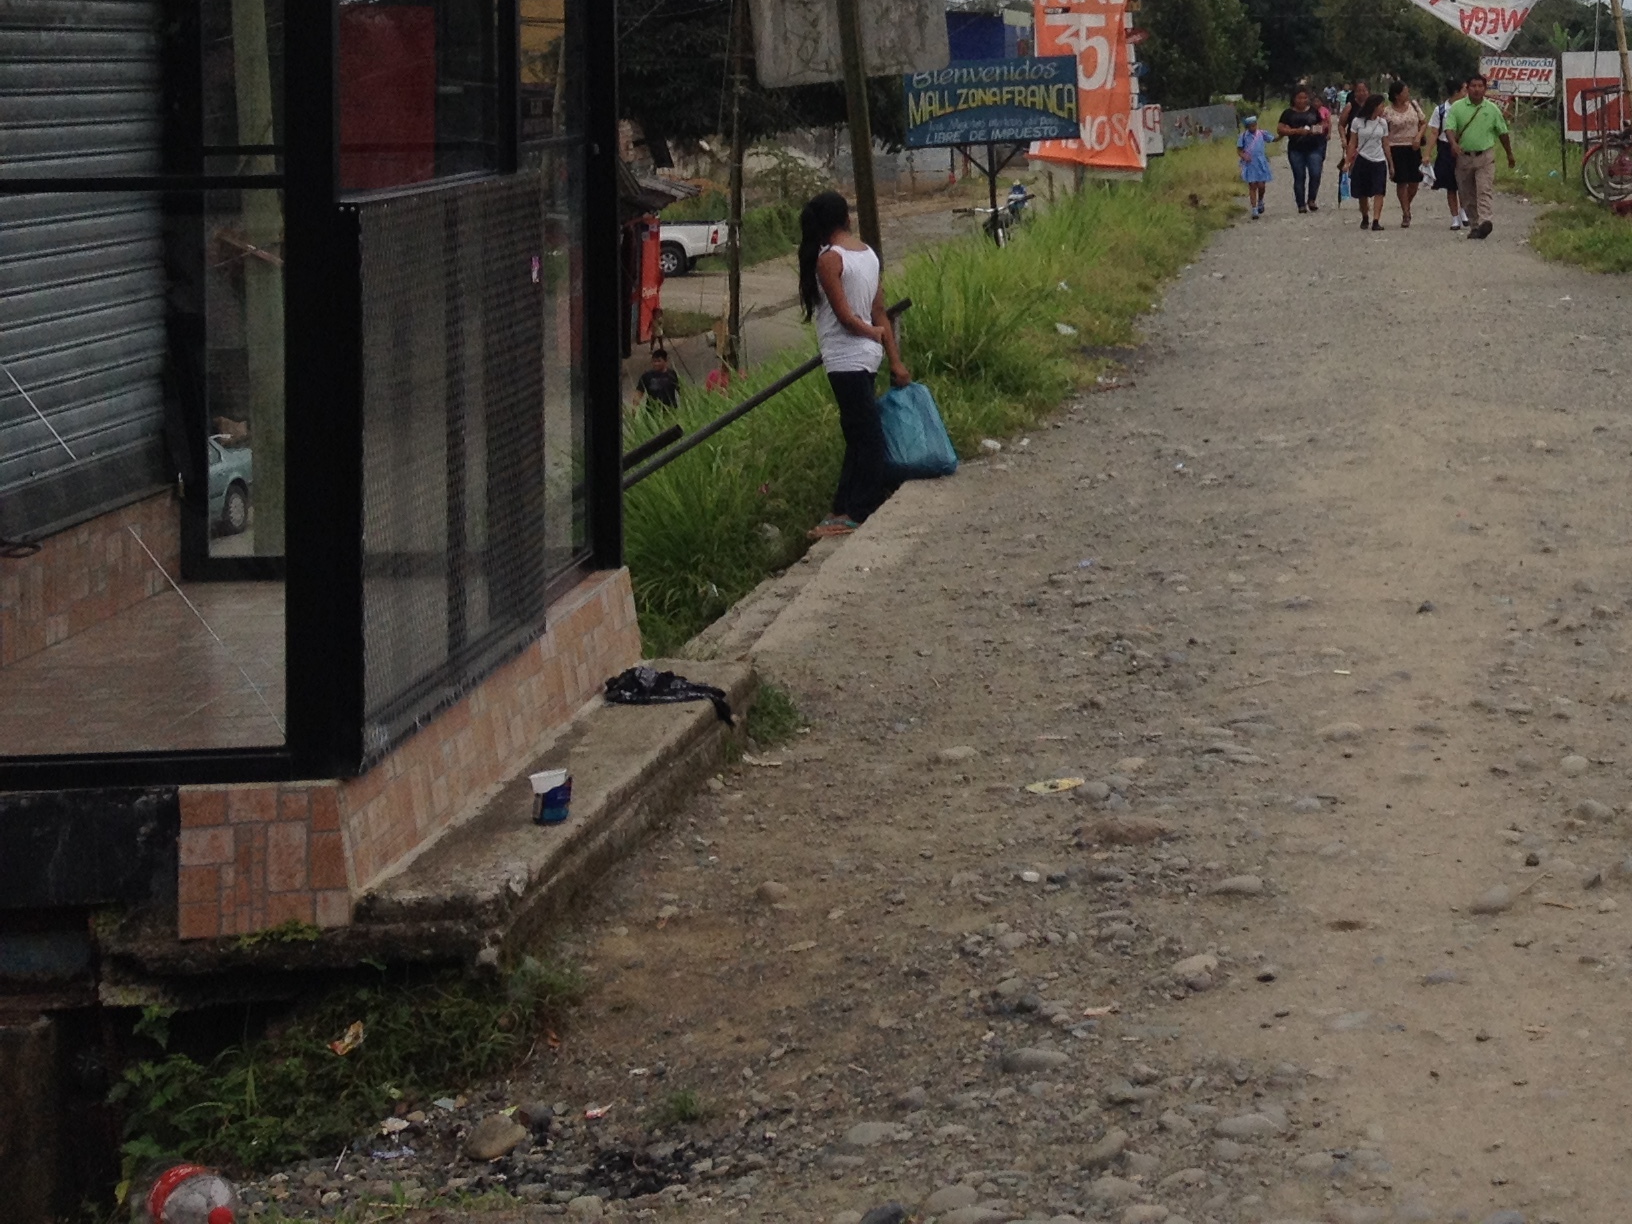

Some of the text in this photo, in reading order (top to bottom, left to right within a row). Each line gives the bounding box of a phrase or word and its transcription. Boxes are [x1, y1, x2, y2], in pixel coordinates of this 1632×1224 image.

[912, 60, 1059, 89] Bienvenidos
[1486, 67, 1553, 82] JOSEPH
[908, 83, 1077, 129] MALL ZONA FRANCA
[925, 125, 1060, 145] LIBRE DE IMPUESTO
